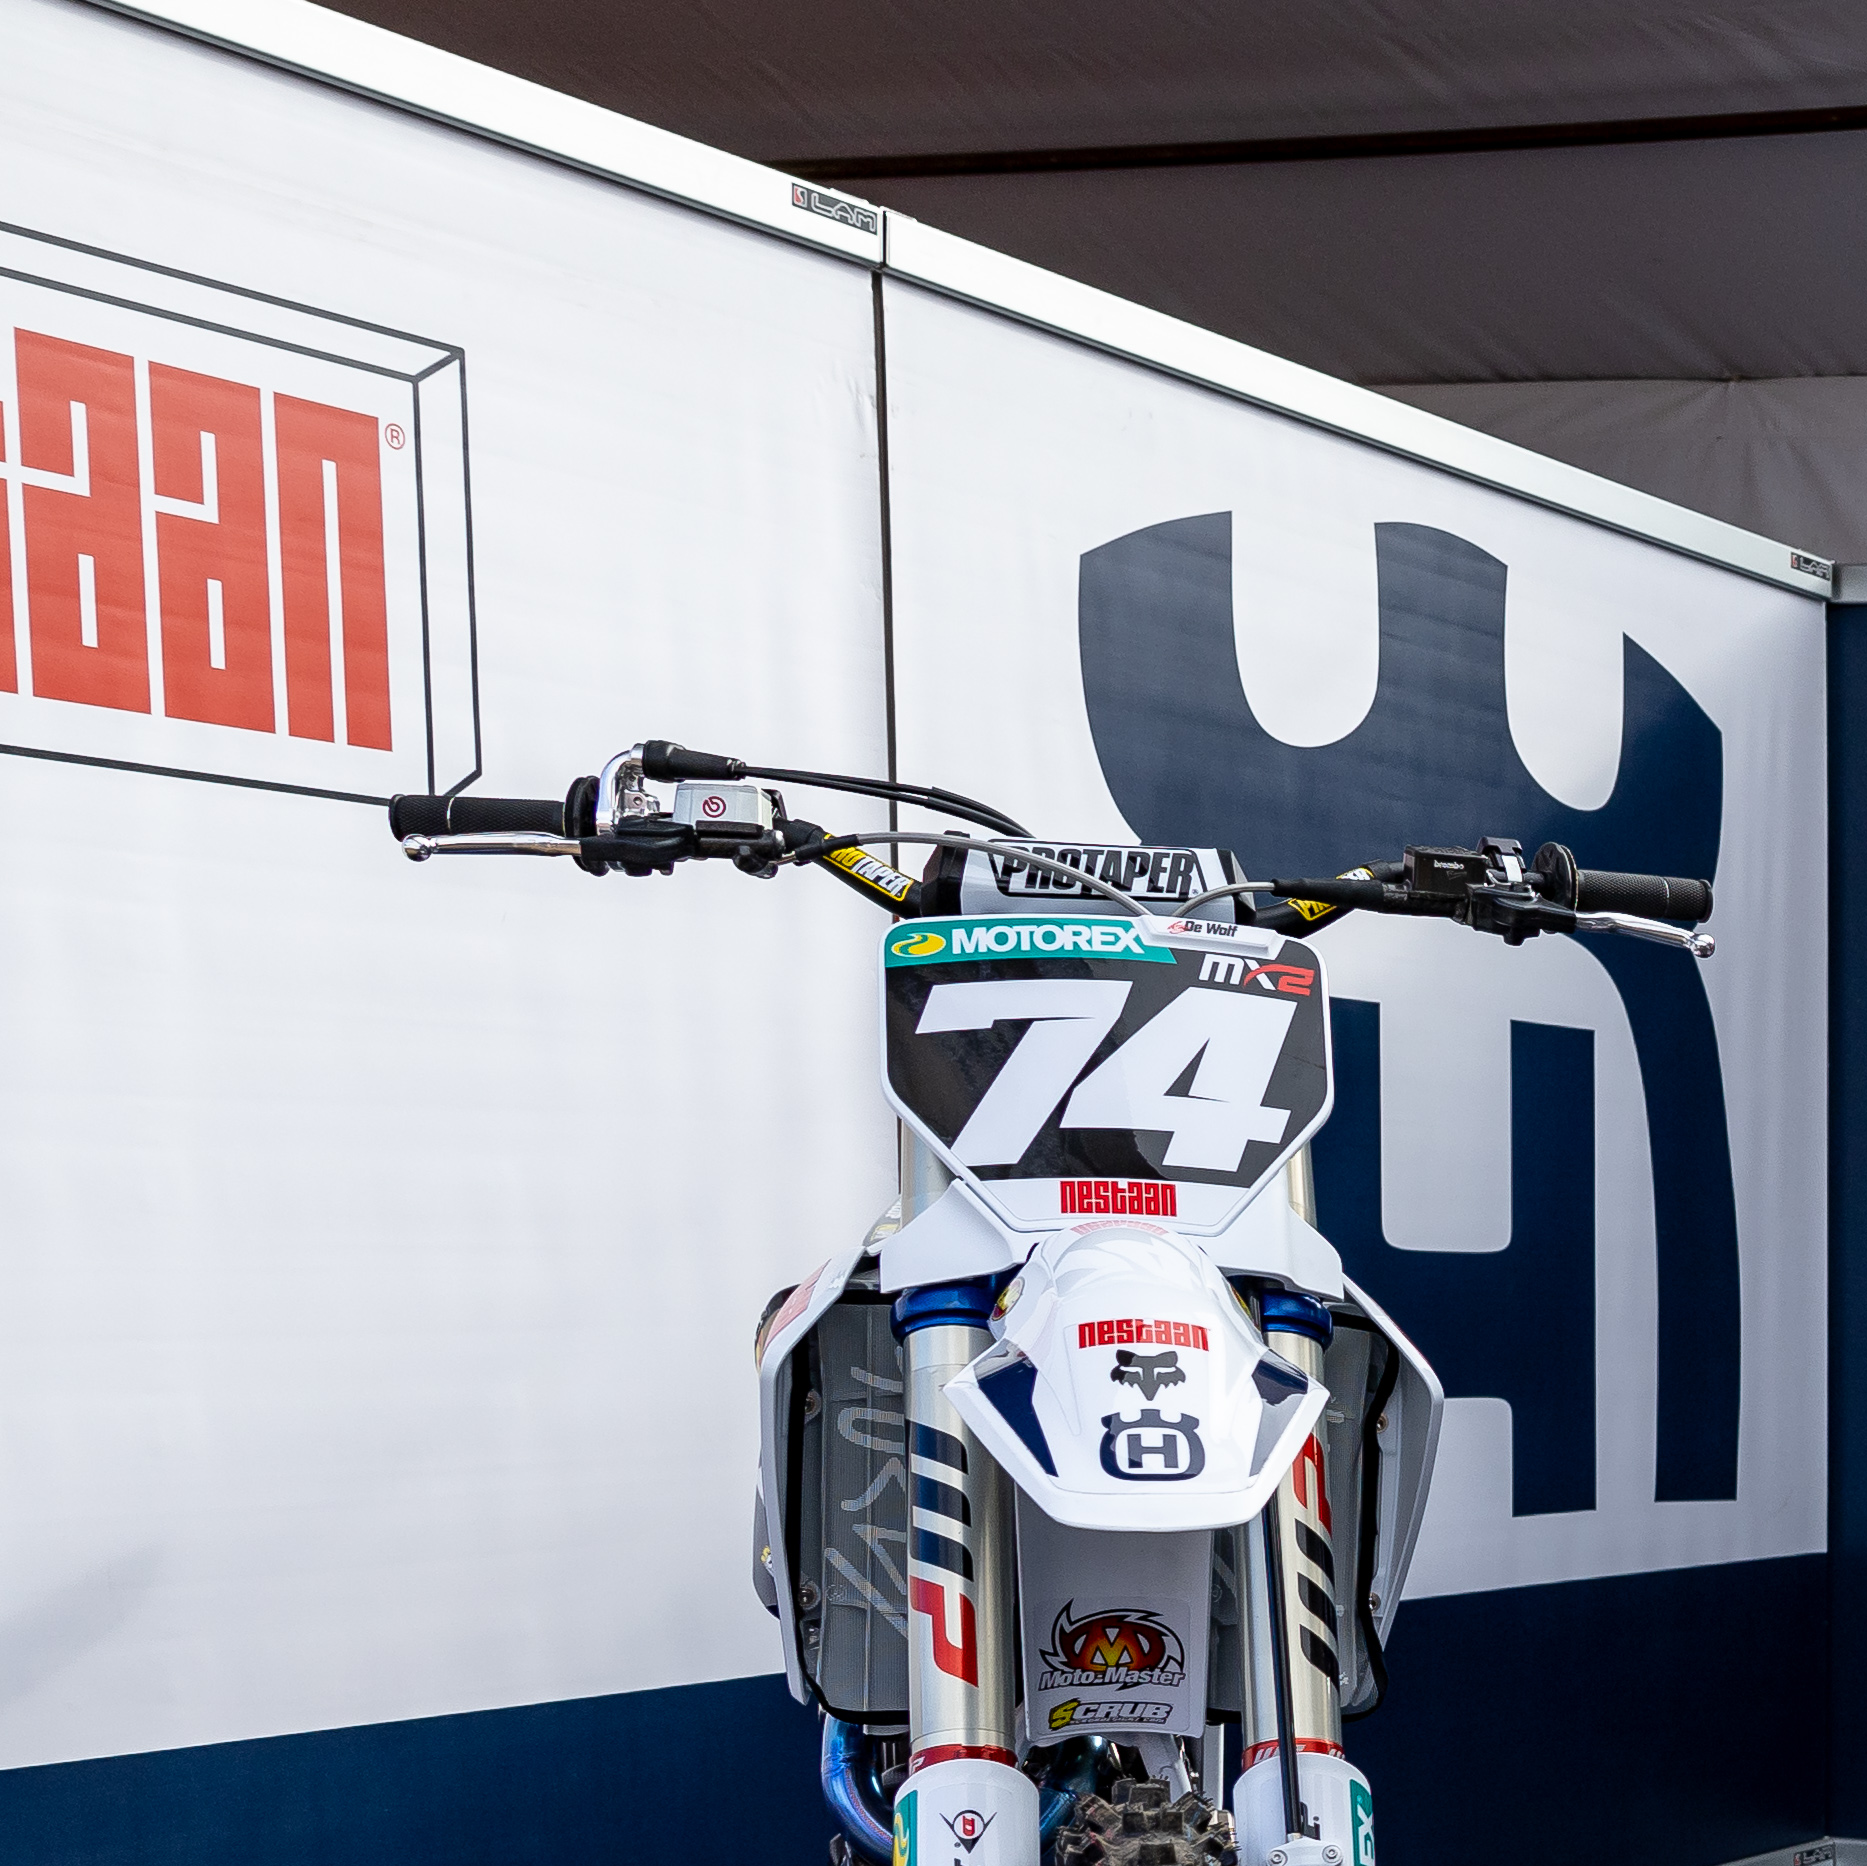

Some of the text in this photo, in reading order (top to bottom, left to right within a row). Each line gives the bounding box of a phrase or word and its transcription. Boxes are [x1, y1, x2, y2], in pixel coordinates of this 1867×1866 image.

[1000, 847, 1194, 895] PROTAPER
[951, 924, 1145, 955] MOTOREX
[1183, 920, 1203, 933] De
[1204, 922, 1238, 938] Wolf
[1198, 954, 1315, 997] MX2
[915, 978, 1298, 1173] 74
[1059, 1180, 1178, 1218] nestaan
[1077, 1318, 1211, 1352] nestaan
[1048, 1697, 1174, 1731] SCRUB
